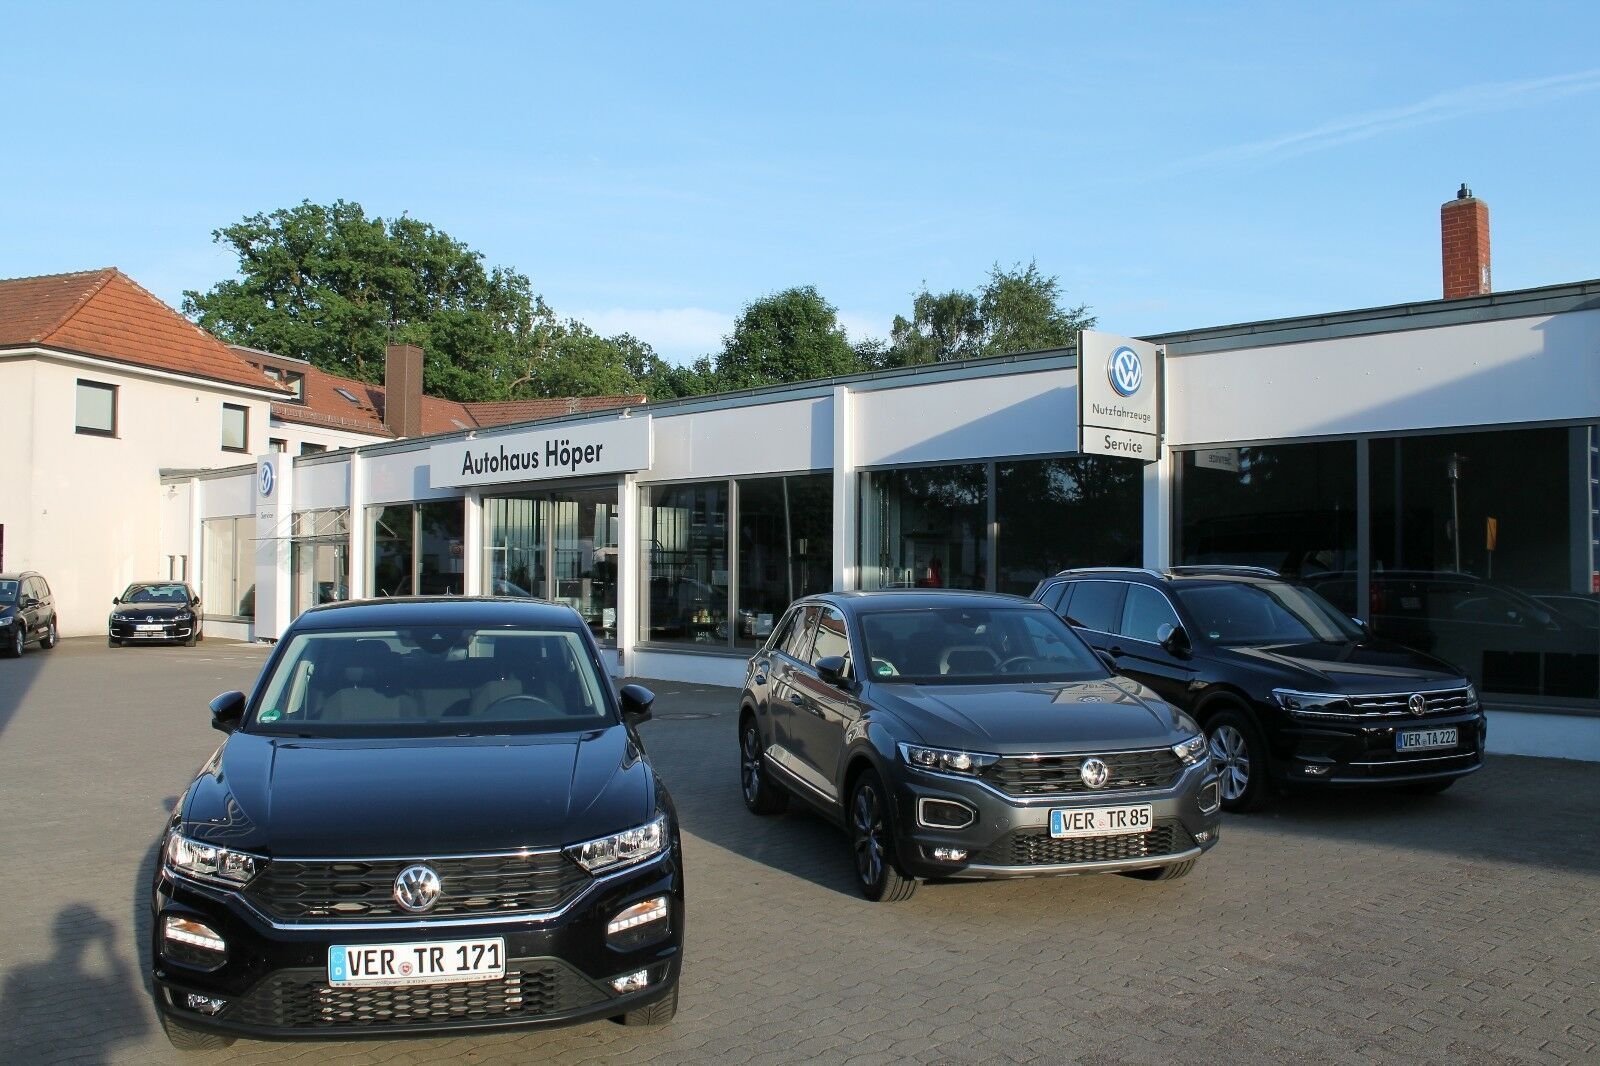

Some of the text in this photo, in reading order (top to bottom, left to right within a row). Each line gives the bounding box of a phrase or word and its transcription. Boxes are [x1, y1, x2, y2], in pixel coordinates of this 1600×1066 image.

[1092, 403, 1151, 423] Nutzfahrzeuge
[1104, 435, 1143, 453] Service
[462, 439, 603, 475] Autohaus Höper
[1403, 730, 1456, 746] VER TA 222
[1063, 808, 1149, 831] VER TR 85
[347, 943, 502, 976] VER TR 171
